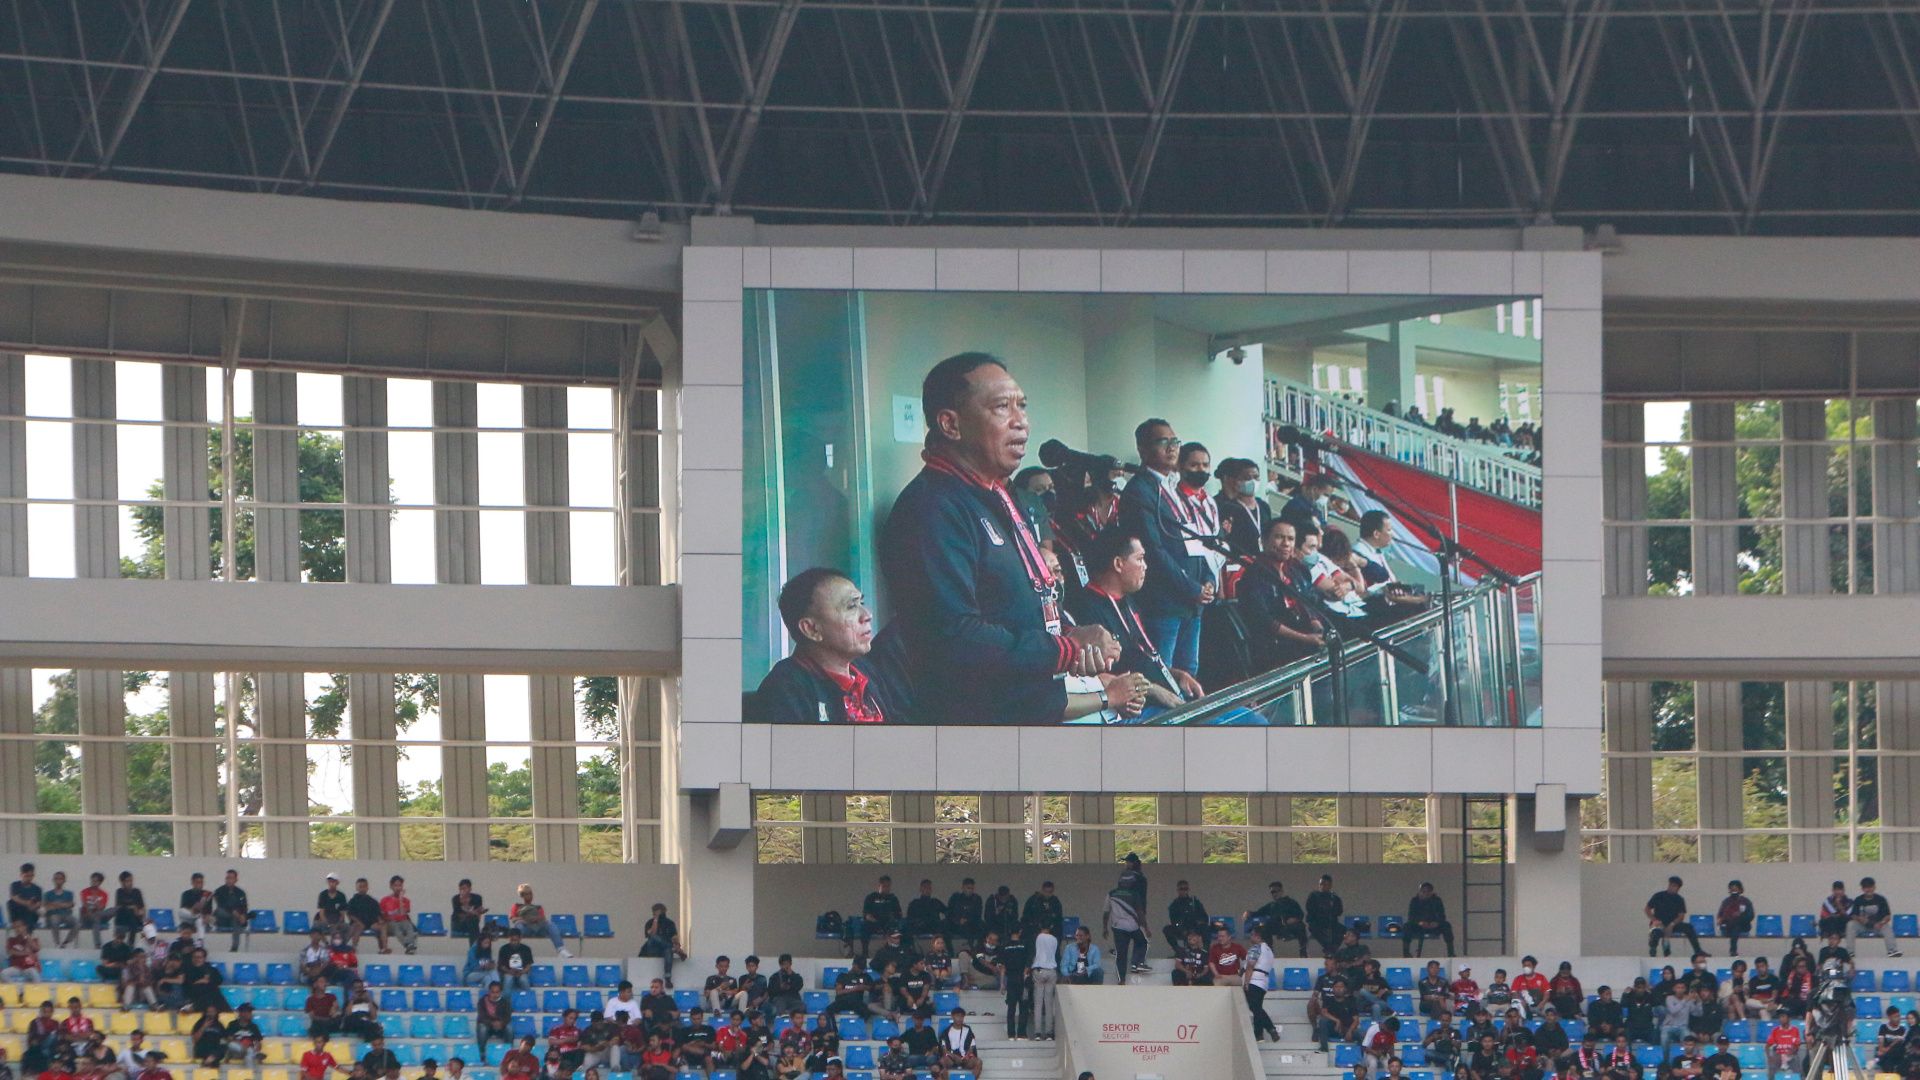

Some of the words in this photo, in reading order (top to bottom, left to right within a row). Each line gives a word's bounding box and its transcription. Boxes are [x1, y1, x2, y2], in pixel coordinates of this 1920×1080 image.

[1102, 1023, 1140, 1032] SEKTOR
[1177, 1024, 1198, 1040] 07
[1132, 1045, 1170, 1053] KELUAR
